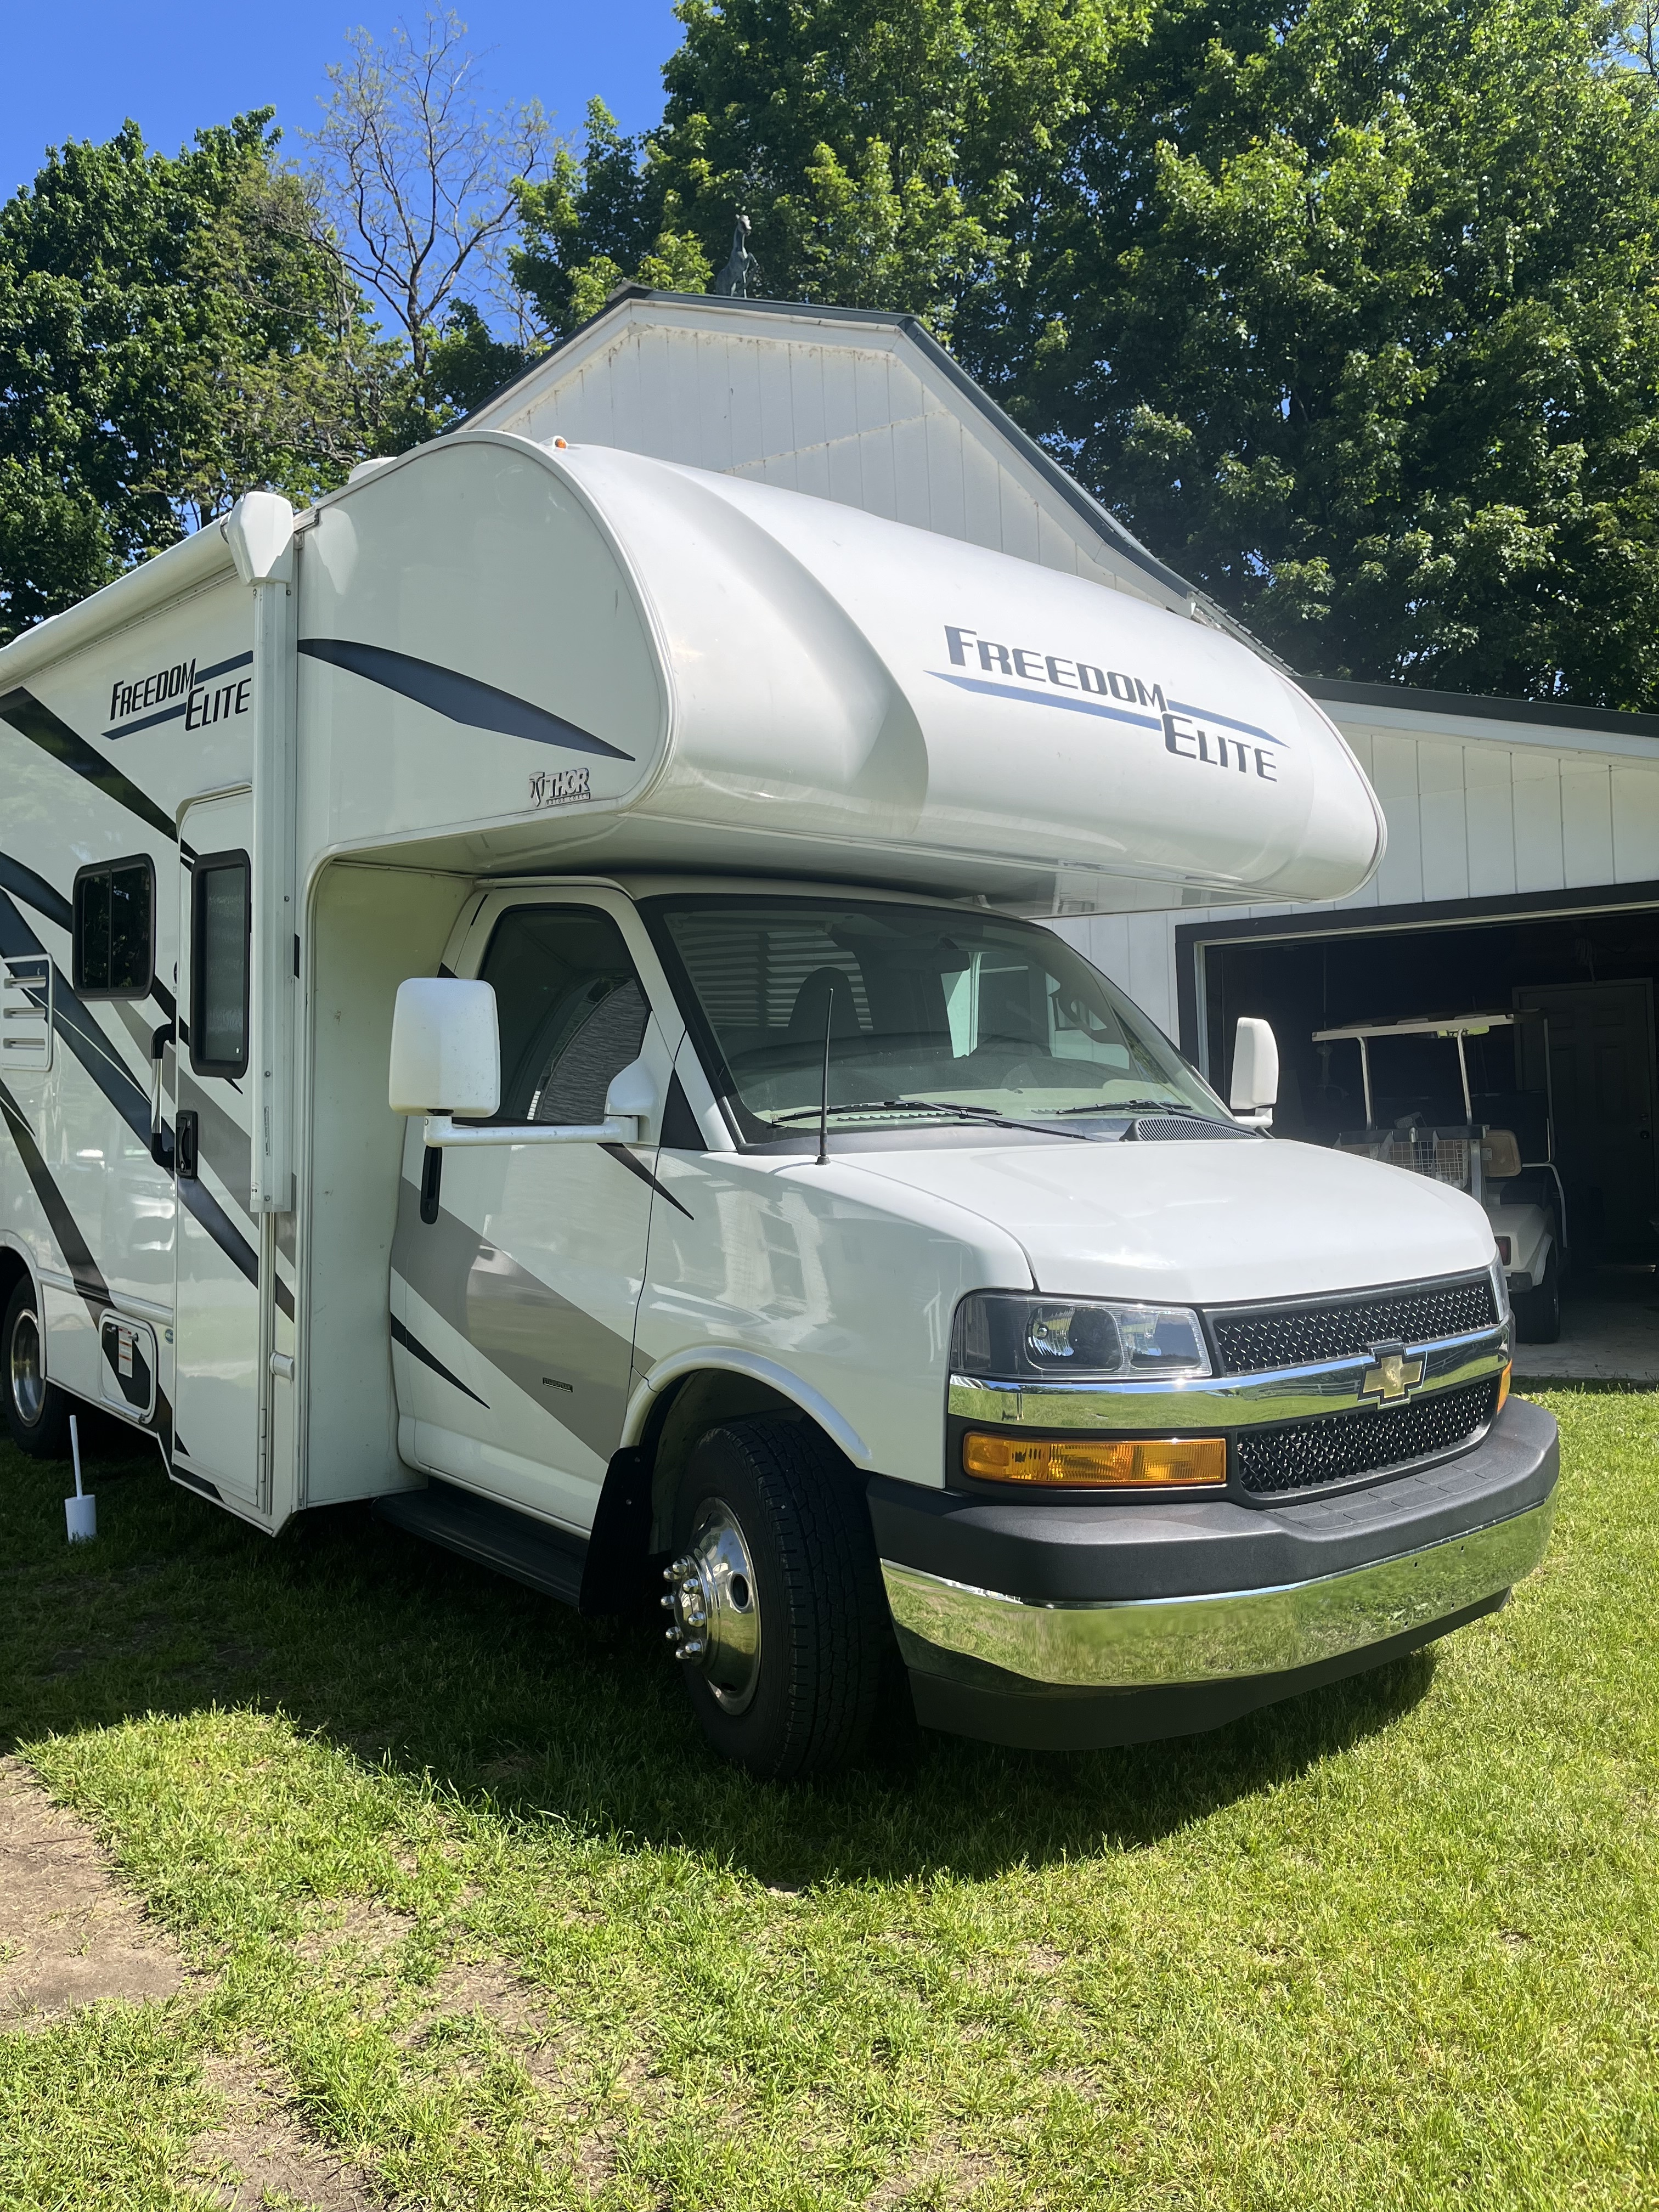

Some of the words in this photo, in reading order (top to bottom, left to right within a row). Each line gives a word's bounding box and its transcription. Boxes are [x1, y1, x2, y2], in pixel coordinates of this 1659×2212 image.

[110, 658, 196, 721] FREEDOM
[944, 625, 1168, 712] FREEDOM
[185, 678, 252, 731] ELITE
[1162, 713, 1278, 782] ELITE
[545, 768, 590, 798] THOR
[546, 797, 565, 805] MOTOR
[569, 793, 589, 802] COACH
